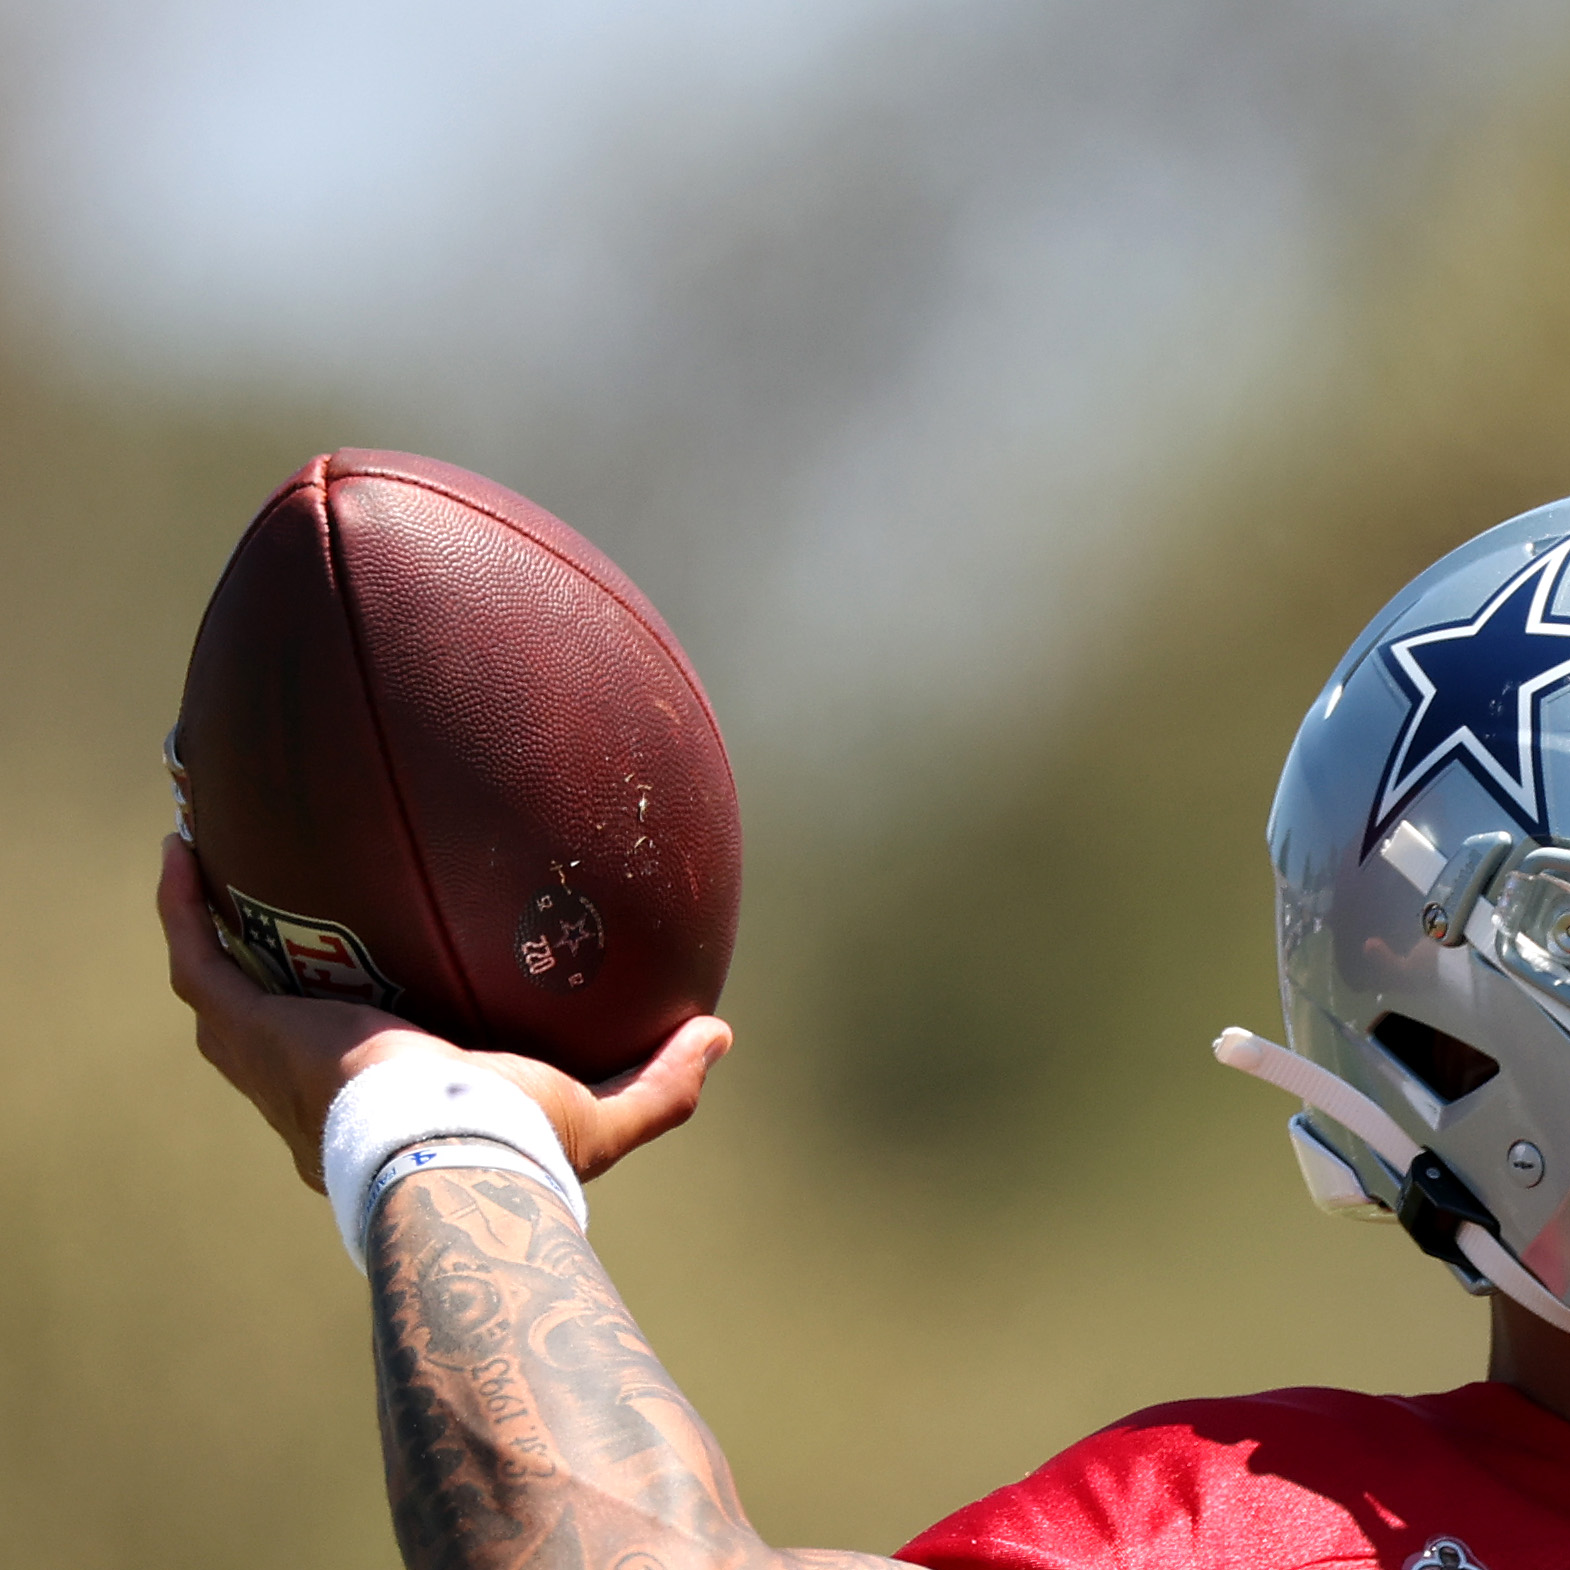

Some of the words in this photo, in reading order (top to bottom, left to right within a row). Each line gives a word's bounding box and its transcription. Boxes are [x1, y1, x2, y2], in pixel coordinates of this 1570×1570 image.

[285, 934, 375, 1003] FL
[521, 935, 556, 974] 220
[472, 1358, 528, 1424] 1993
